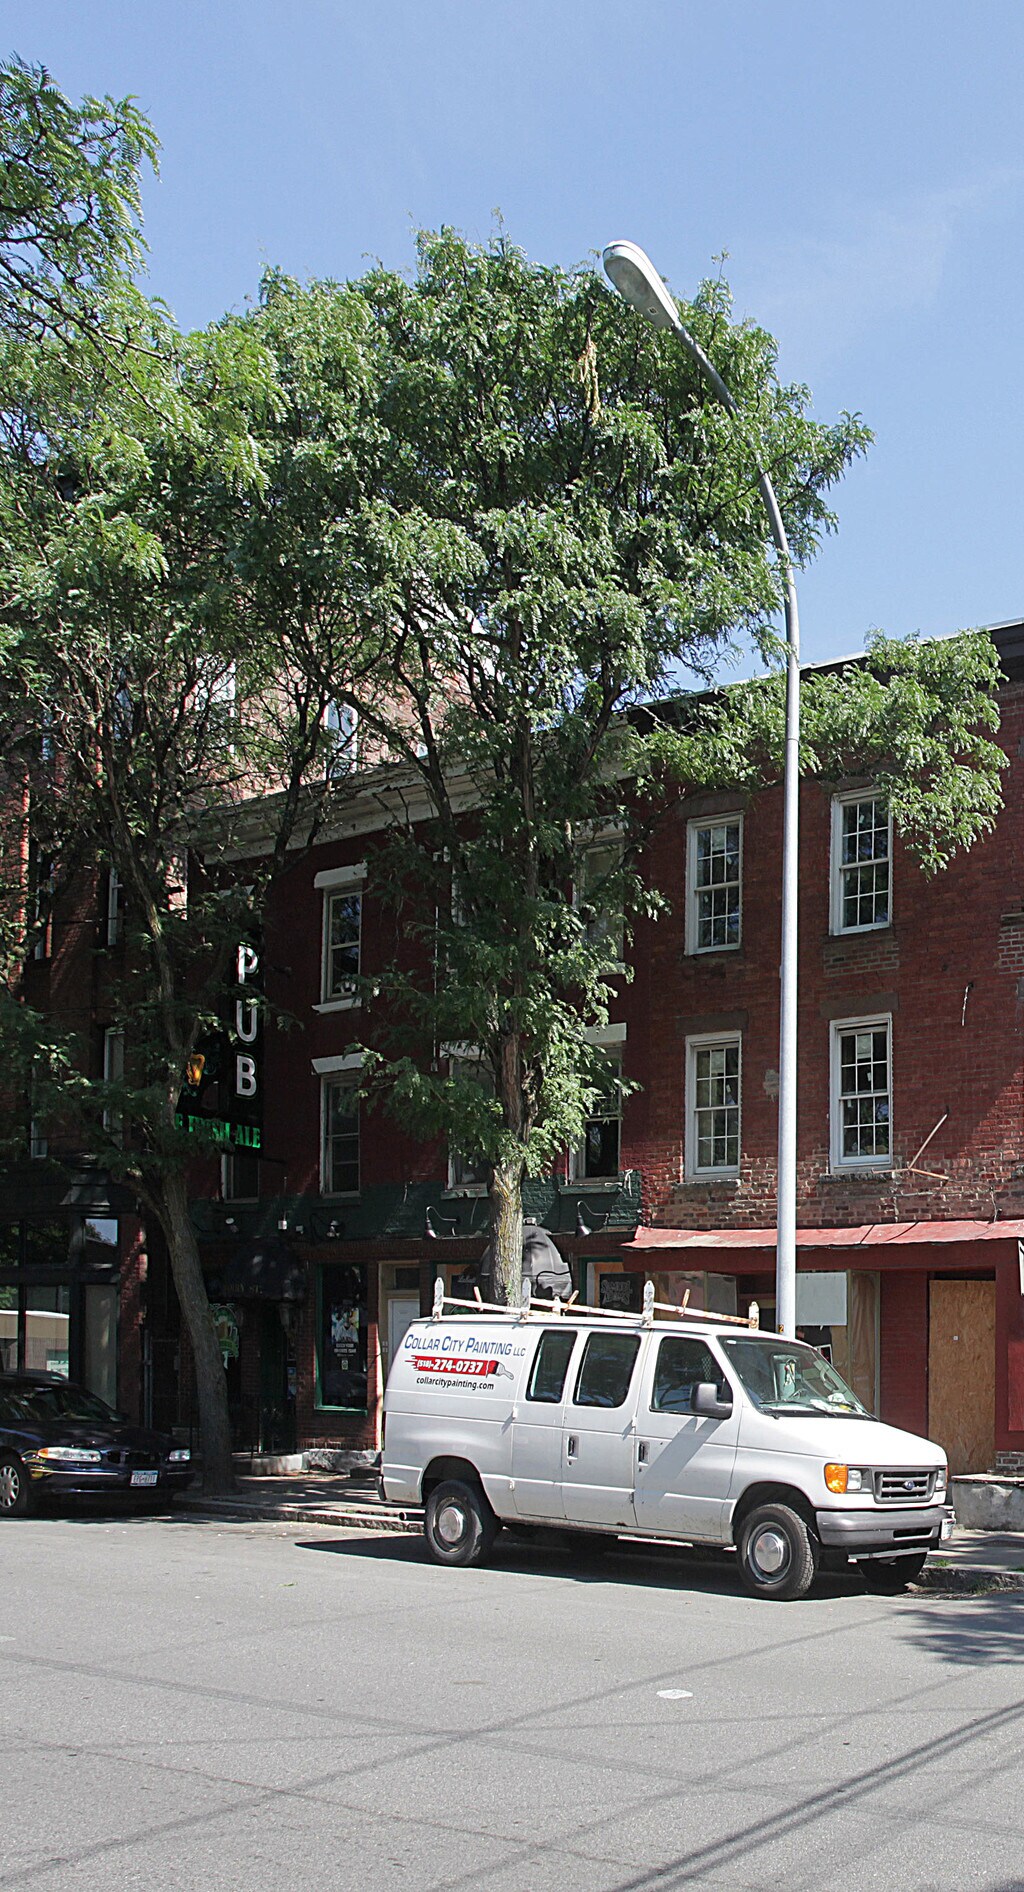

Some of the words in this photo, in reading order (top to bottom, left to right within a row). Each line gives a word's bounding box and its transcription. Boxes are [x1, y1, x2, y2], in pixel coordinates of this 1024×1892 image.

[236, 944, 259, 1097] PUB
[235, 1124, 261, 1149] ALE
[404, 1334, 440, 1351] COLLAR
[441, 1336, 465, 1352] CITY
[465, 1337, 513, 1355] PAINTING
[513, 1347, 526, 1357] LLC
[416, 1376, 494, 1390] collarcitypainting.com
